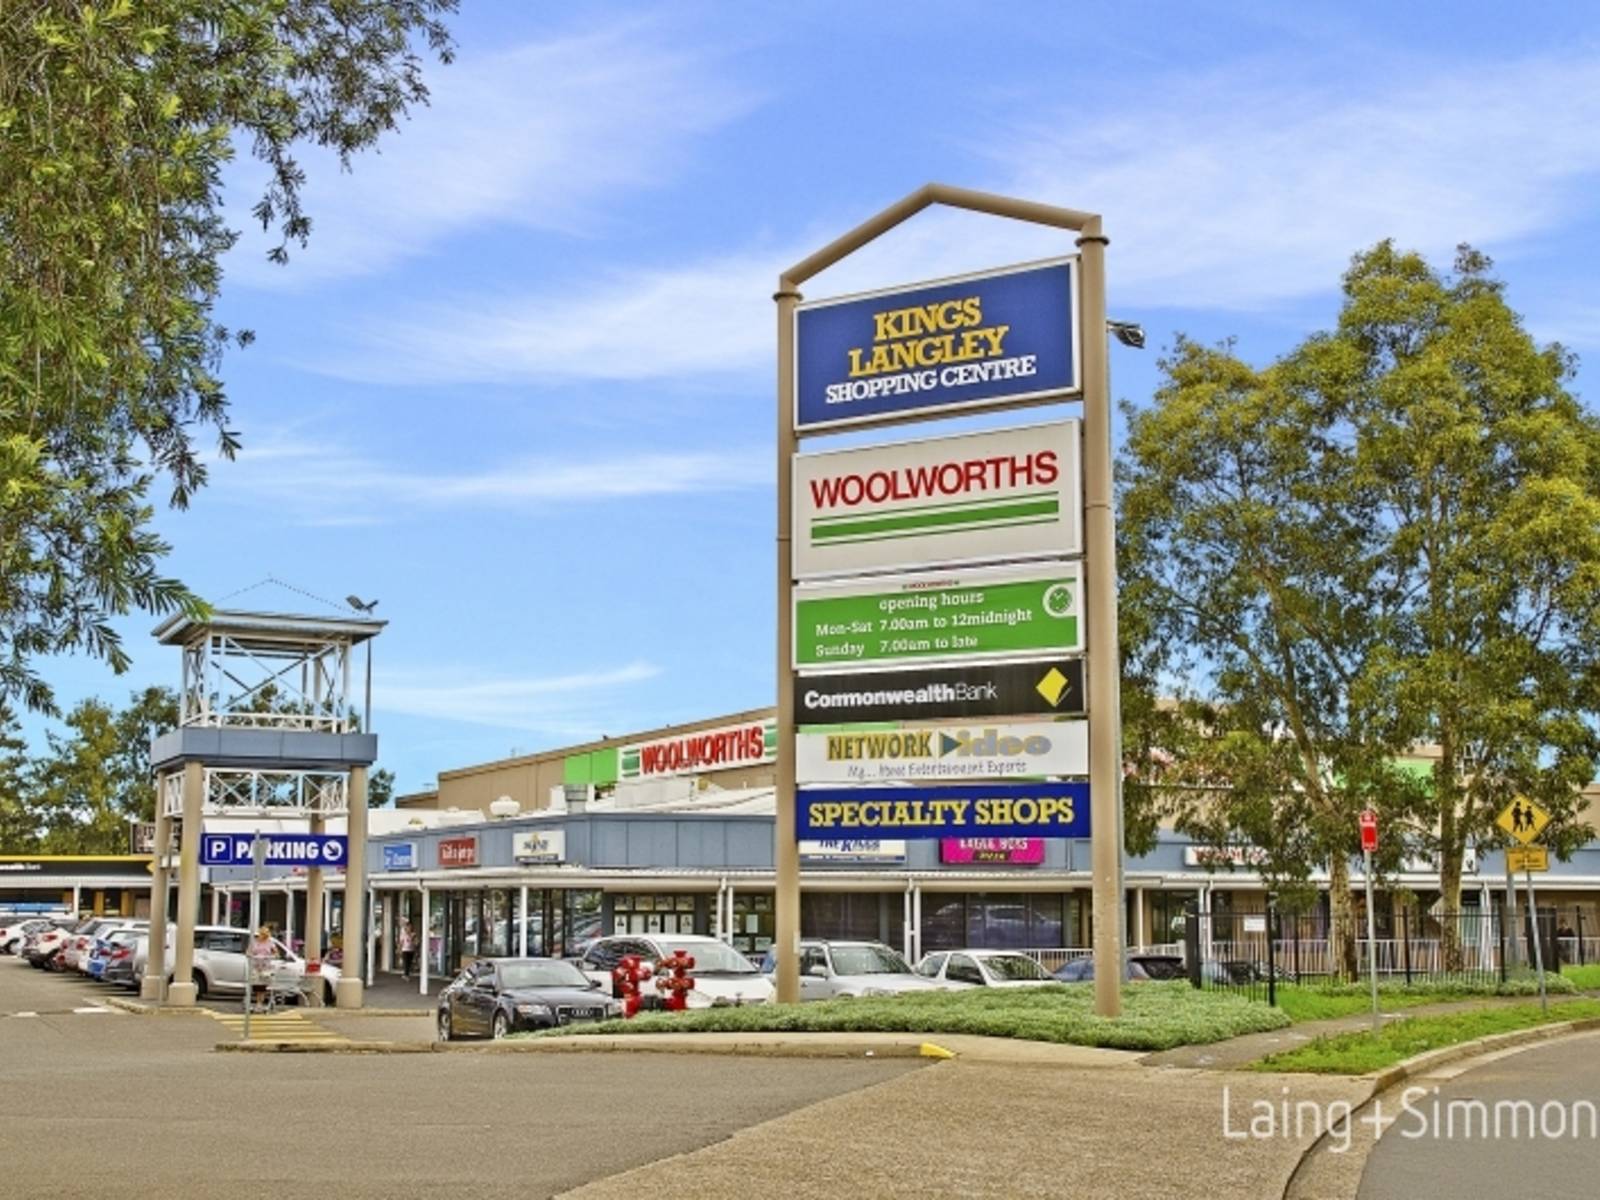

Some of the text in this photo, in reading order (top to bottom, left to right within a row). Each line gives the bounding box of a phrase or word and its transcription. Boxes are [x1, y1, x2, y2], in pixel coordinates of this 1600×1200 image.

[873, 297, 982, 342] KINGS
[848, 325, 1009, 377] LANGLEY
[825, 355, 1037, 404] SHOPPING CENTRE
[810, 450, 1059, 509] WOOLWORTHS
[879, 595, 937, 613] opening
[933, 617, 947, 628] to
[951, 609, 1033, 627] 12midnight
[815, 642, 865, 658] Sunday
[935, 637, 949, 648] to
[642, 727, 764, 775] WOOLWORTHS
[827, 732, 933, 760] NETWORK
[808, 797, 1075, 827] SPECIALTY SHOPS
[211, 841, 226, 859] P
